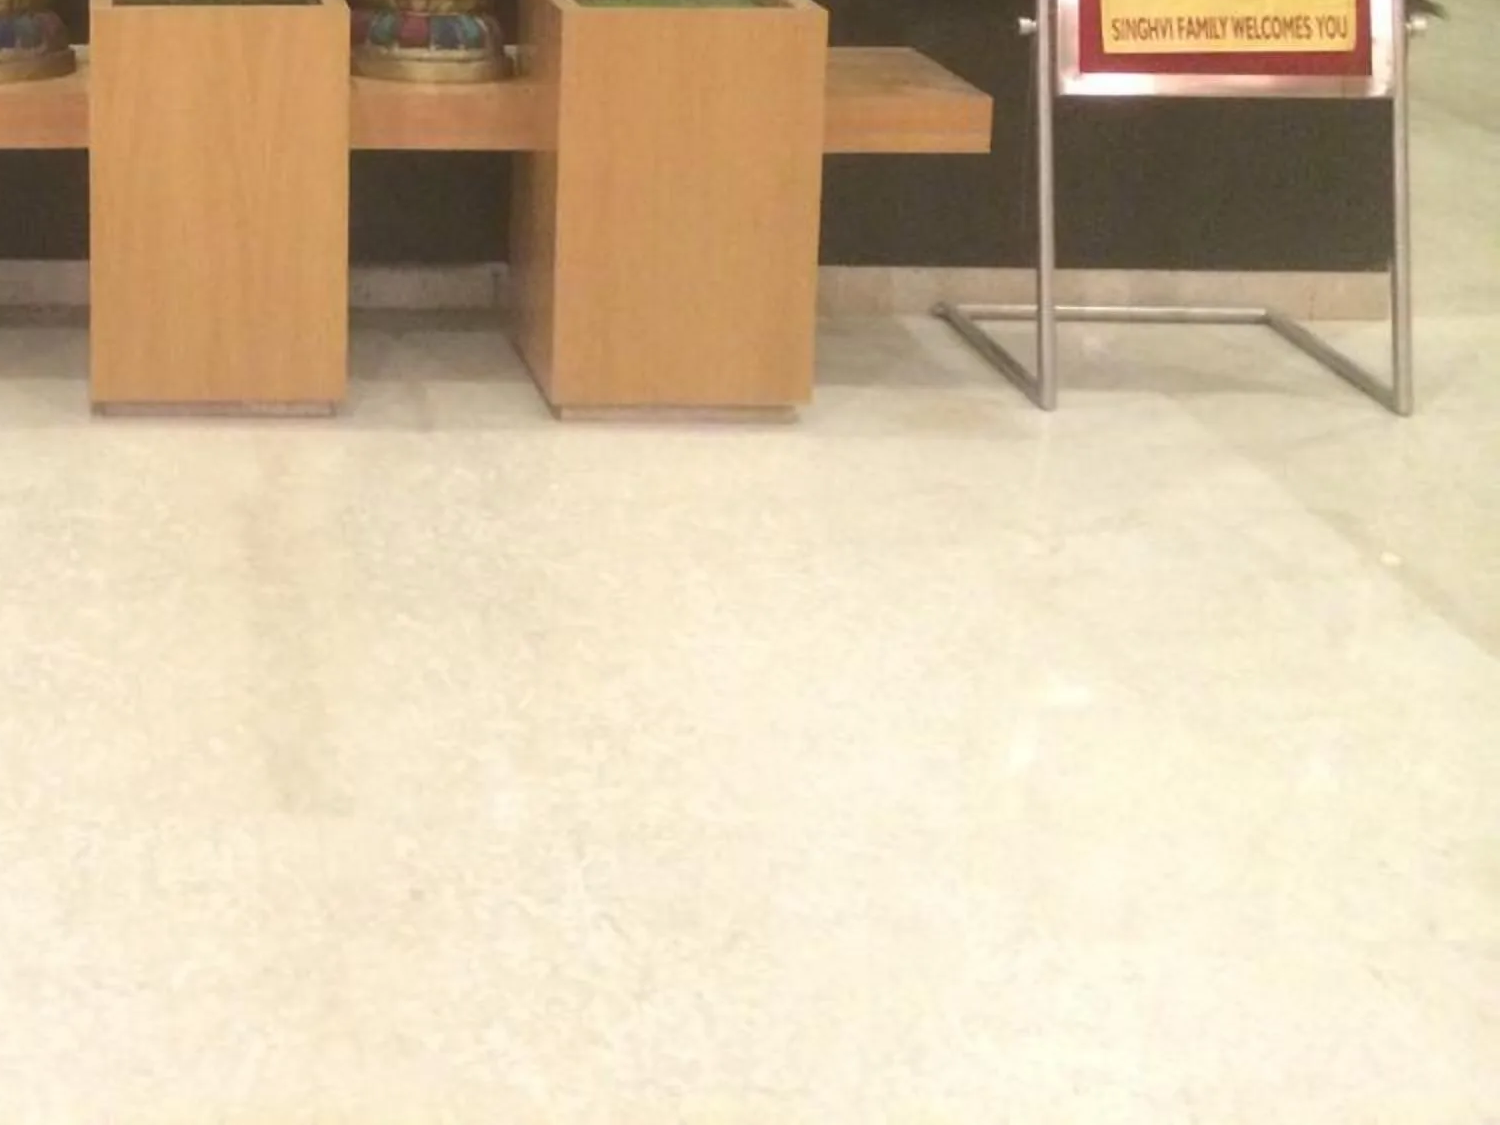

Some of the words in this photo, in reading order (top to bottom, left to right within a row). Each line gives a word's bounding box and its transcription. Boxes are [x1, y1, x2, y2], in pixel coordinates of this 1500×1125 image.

[1111, 17, 1173, 42] SINGHVI
[1177, 16, 1228, 41] FAMILY
[1231, 15, 1313, 41] WELCOMES
[1315, 15, 1348, 41] YOU
